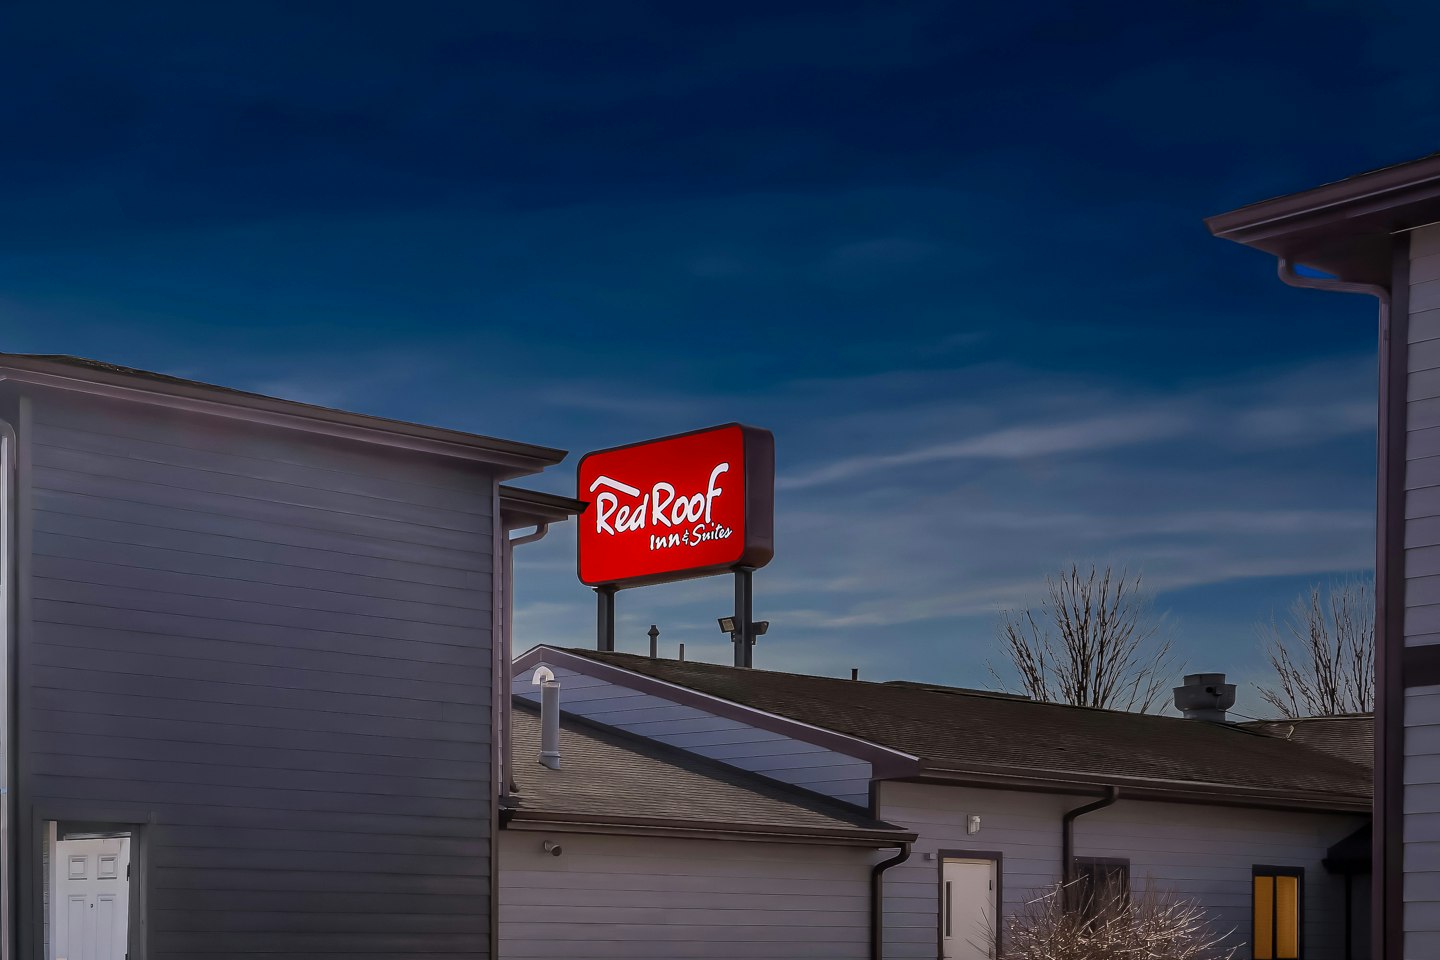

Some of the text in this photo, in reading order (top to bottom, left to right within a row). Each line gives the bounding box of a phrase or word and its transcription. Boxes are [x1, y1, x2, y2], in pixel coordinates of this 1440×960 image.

[596, 462, 729, 536] Red Roof
[649, 522, 733, 551] Inn & Suites
